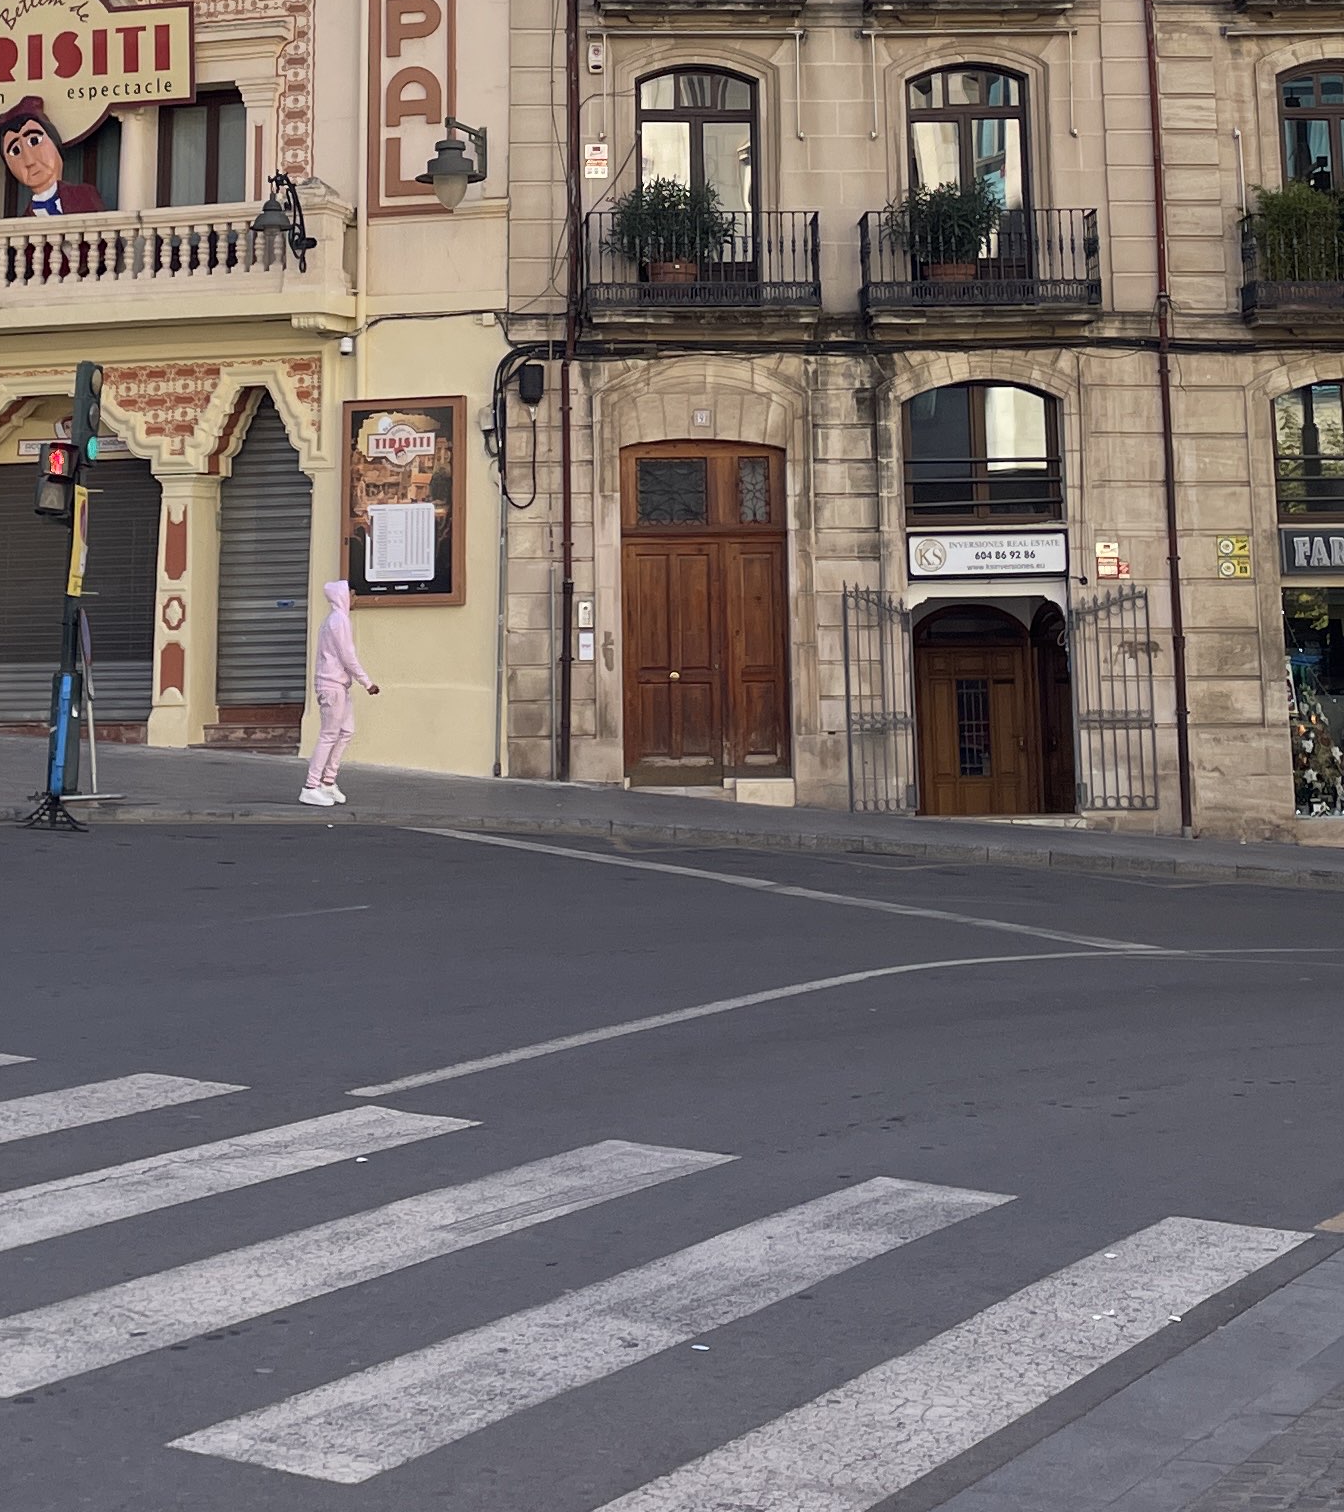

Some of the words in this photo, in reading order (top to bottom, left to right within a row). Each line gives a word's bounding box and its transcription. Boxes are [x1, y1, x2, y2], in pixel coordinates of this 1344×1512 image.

[69, 0, 89, 23] de
[67, 77, 172, 101] espectacle
[949, 540, 1004, 549] INVERSIONES
[1007, 540, 1027, 548] REAL
[1031, 539, 1060, 548] ESTATE
[975, 551, 992, 560] 604
[995, 551, 1006, 559] 86
[1010, 550, 1021, 559] 92
[1024, 550, 1035, 559] 86
